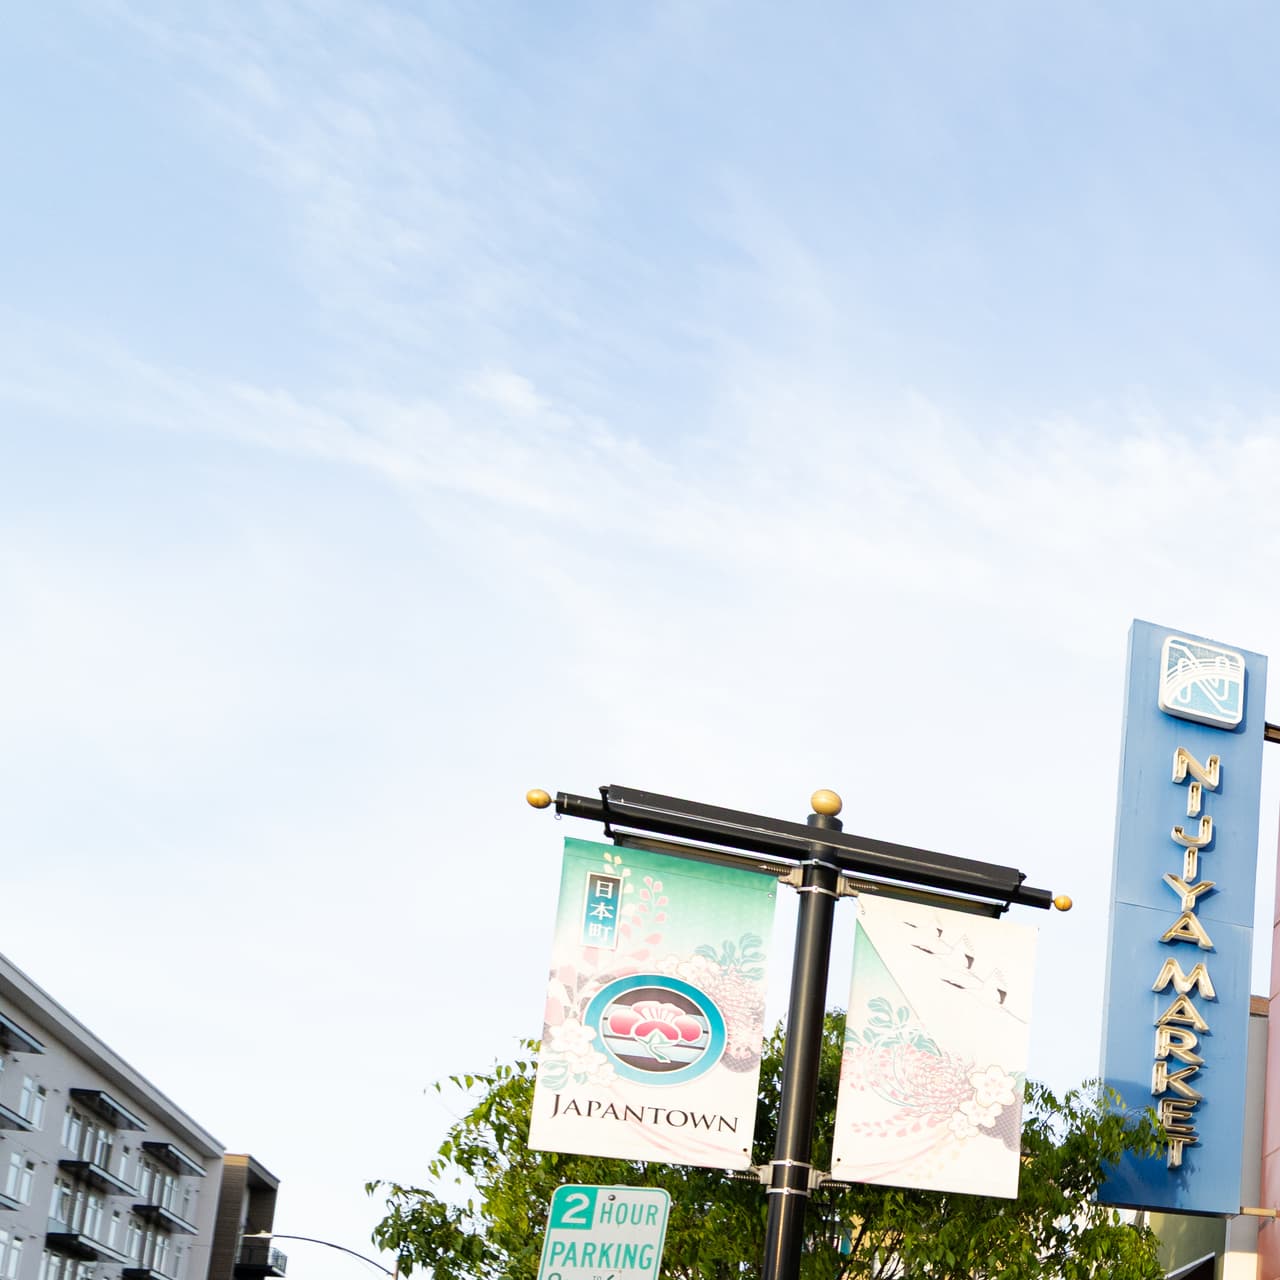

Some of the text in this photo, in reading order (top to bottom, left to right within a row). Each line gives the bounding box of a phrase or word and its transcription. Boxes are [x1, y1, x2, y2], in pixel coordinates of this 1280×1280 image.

[587, 879, 615, 943] 日本町
[1151, 745, 1221, 1169] NIJIYA MARKET
[549, 1094, 740, 1135] JAPANTOWN
[560, 1193, 659, 1226] 2 HOUR
[548, 1241, 655, 1270] PARKING
